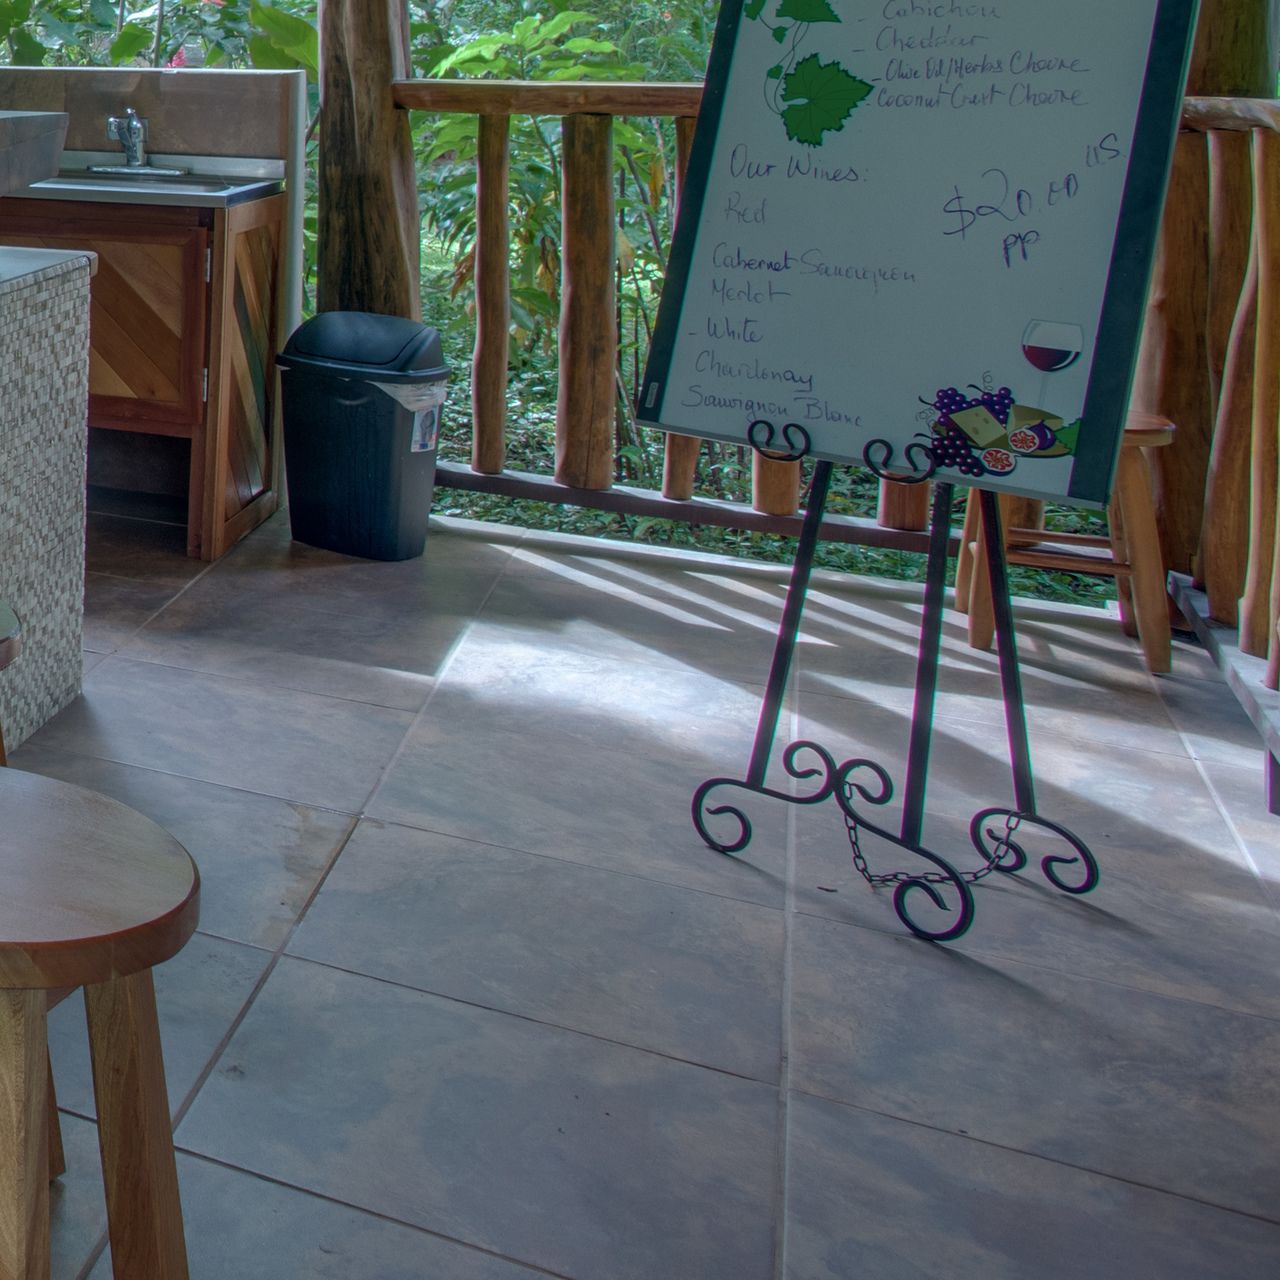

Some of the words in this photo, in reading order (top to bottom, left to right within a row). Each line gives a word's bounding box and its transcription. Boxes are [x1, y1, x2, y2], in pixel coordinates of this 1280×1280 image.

[729, 143, 776, 179] Our
[725, 191, 768, 224] Red
[712, 241, 799, 271] Cabernet
[711, 278, 791, 305] Merlot
[707, 317, 764, 343] White
